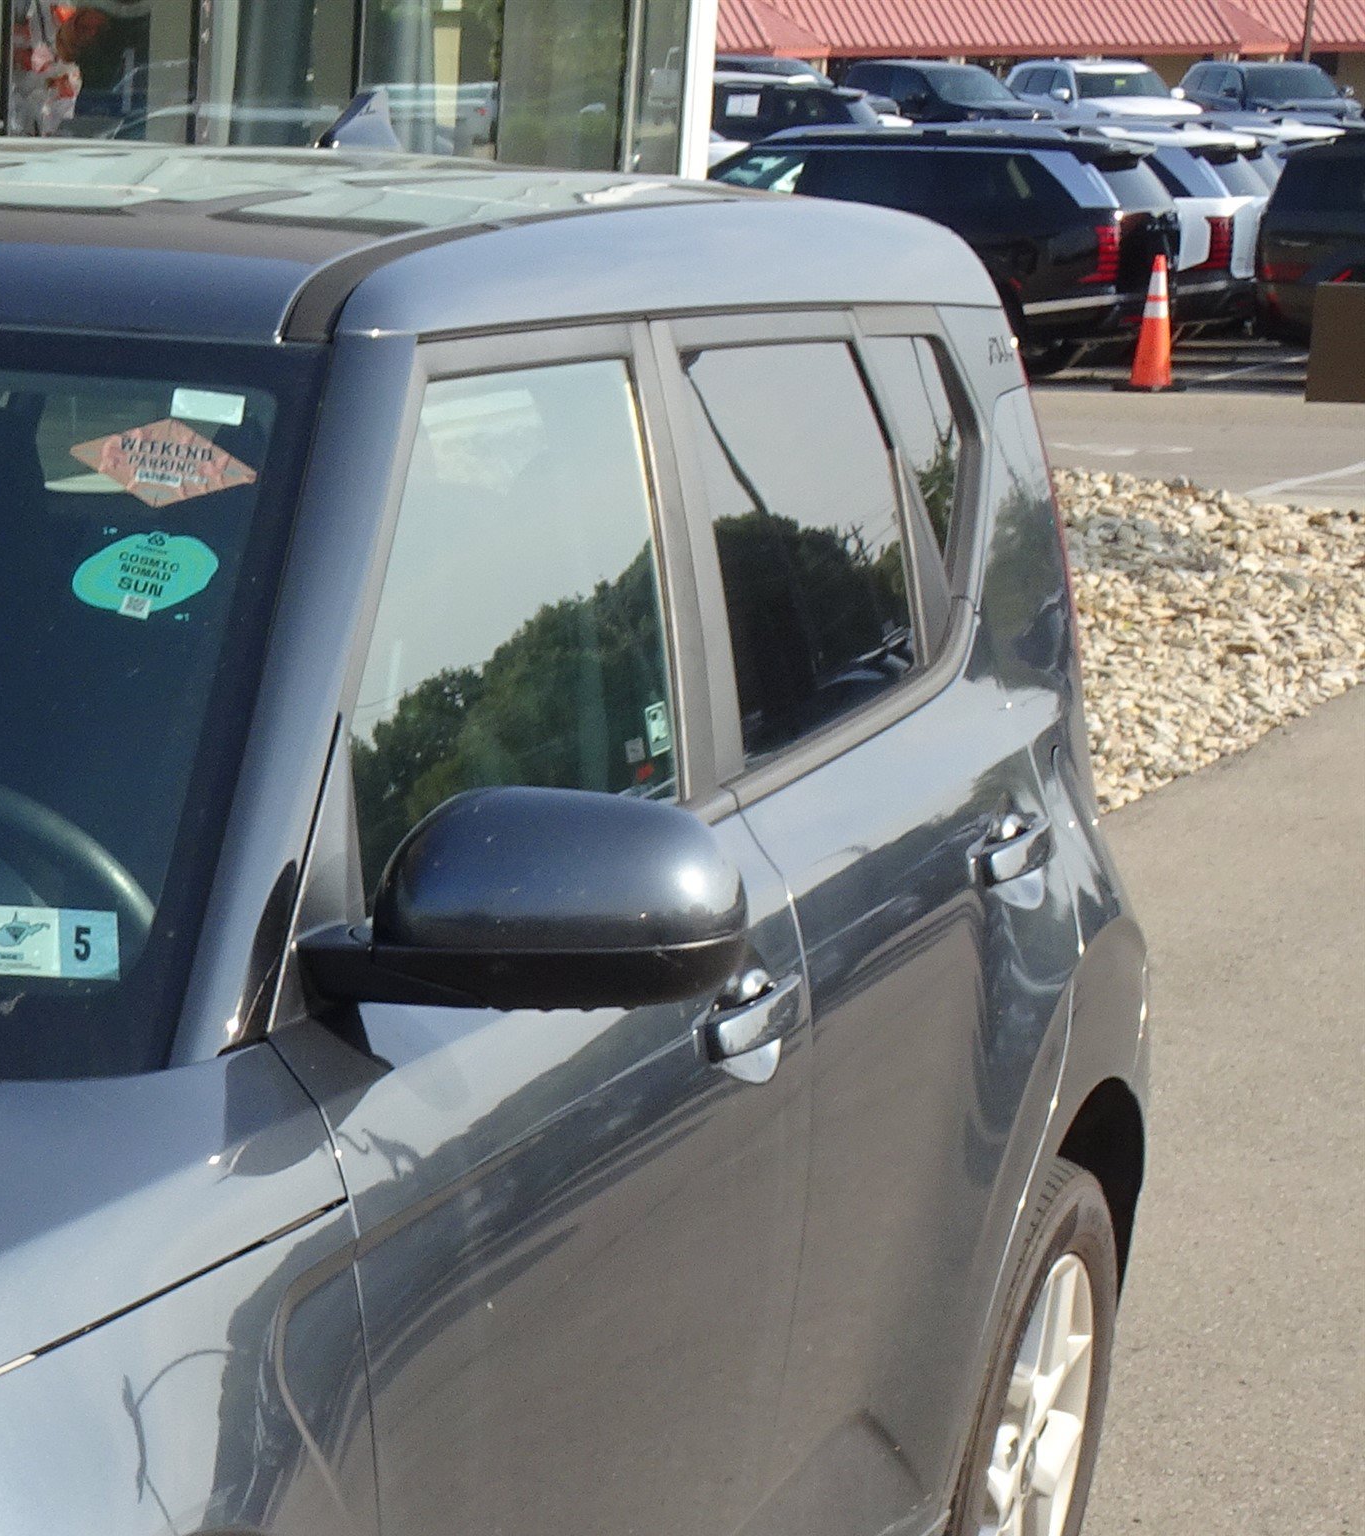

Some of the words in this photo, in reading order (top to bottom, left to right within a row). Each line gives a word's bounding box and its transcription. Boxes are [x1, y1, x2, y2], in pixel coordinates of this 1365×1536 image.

[120, 438, 213, 461] WEEKEND
[118, 551, 180, 573] COSMIC
[120, 562, 171, 581] NOMAD
[117, 576, 164, 598] SUN
[73, 924, 92, 962] 5
